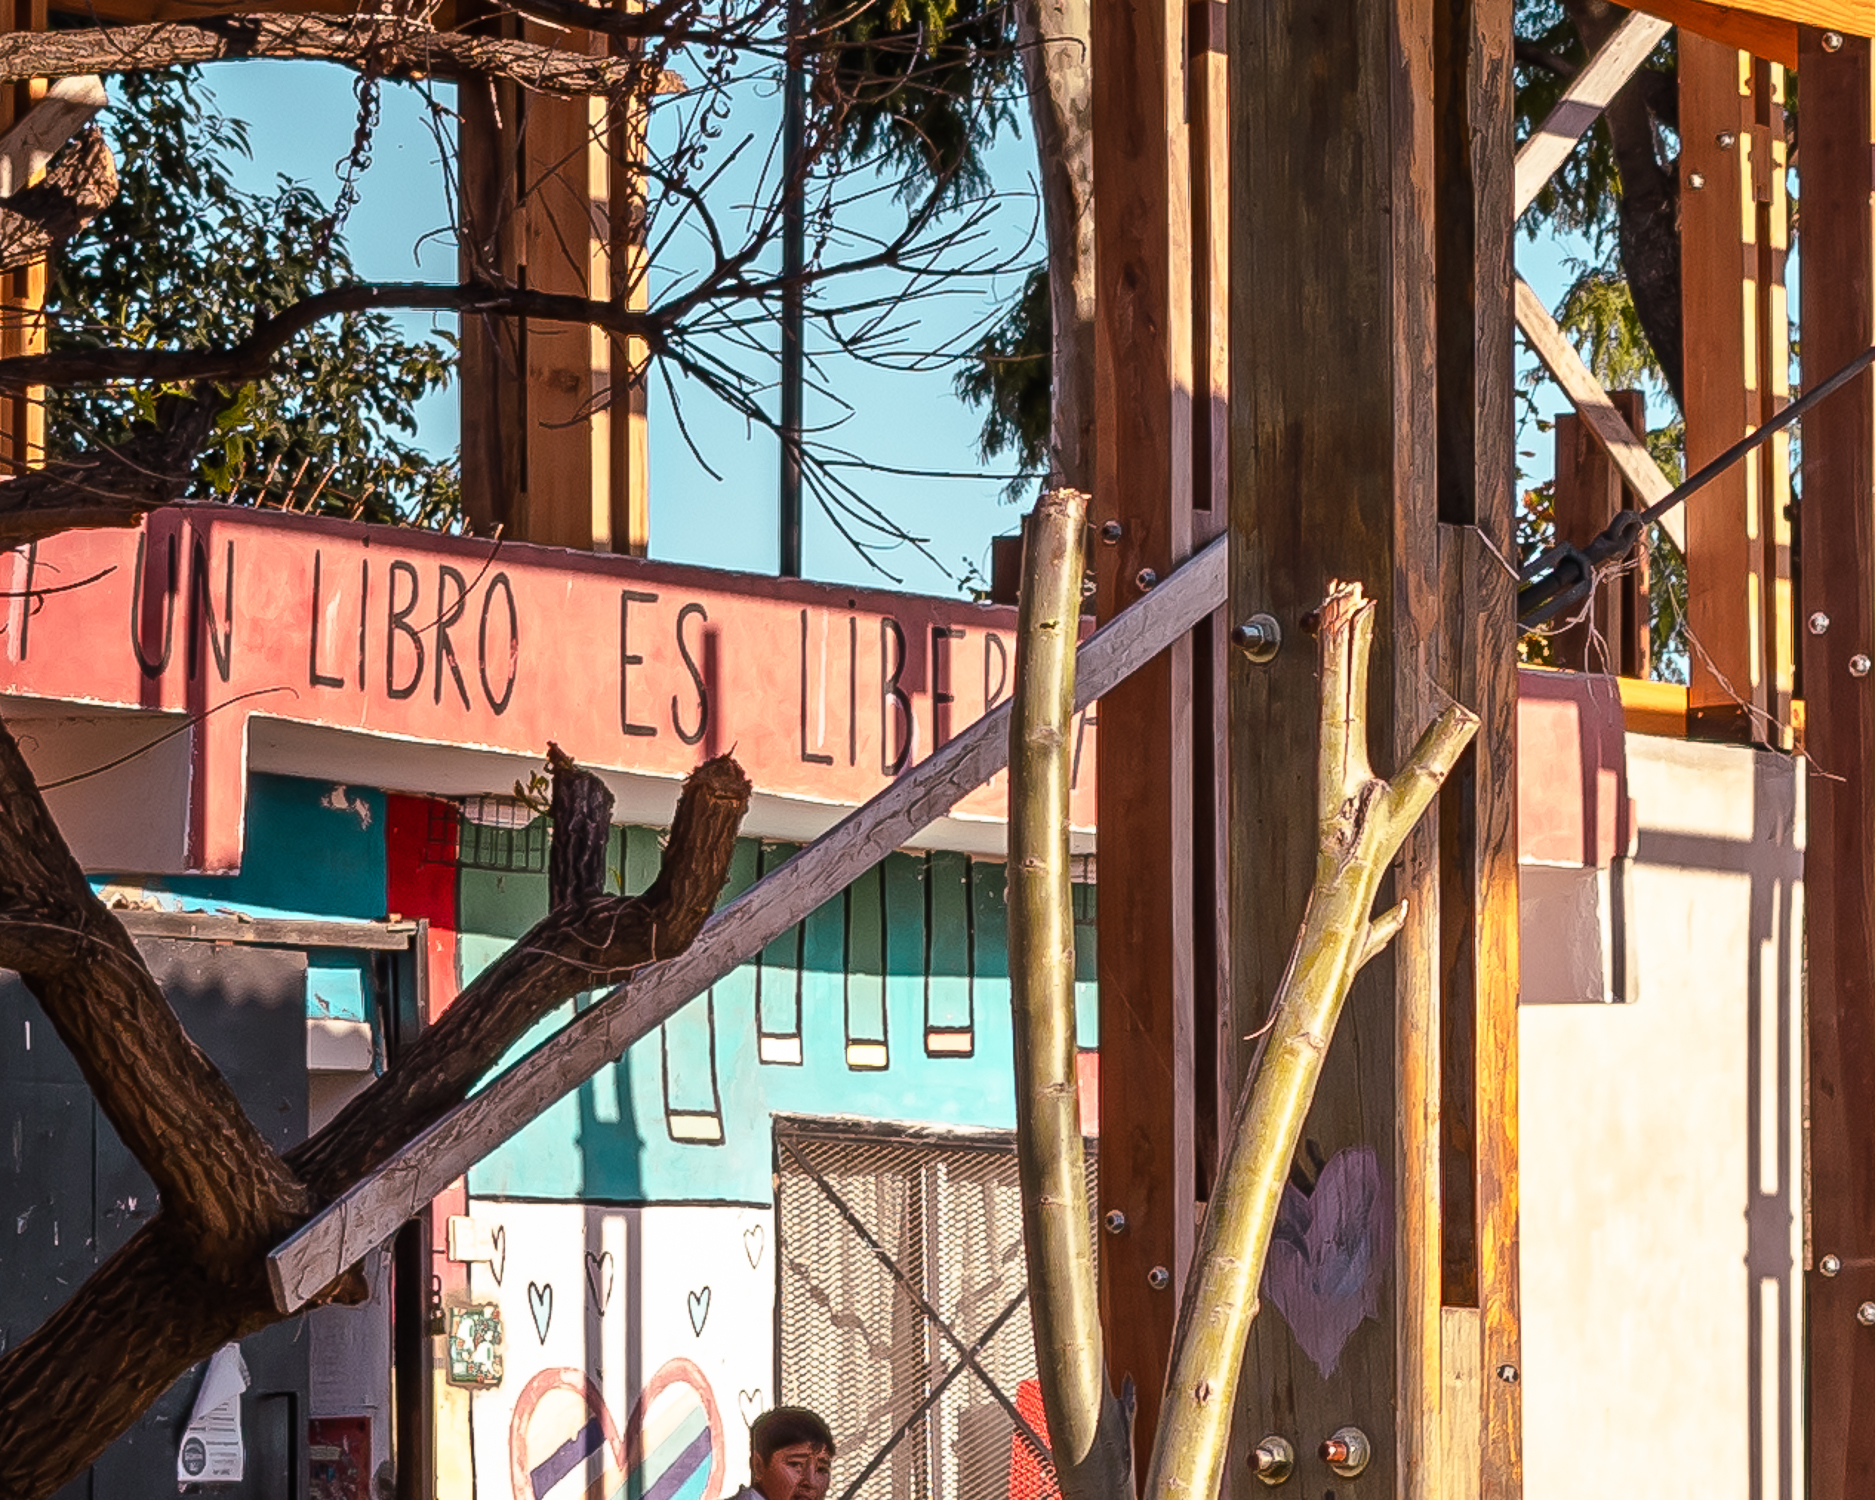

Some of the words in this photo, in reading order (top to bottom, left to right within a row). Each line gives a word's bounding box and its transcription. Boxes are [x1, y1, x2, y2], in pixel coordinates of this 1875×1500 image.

[131, 531, 234, 683] UN
[309, 534, 519, 716] LIBRO
[620, 589, 709, 746] ES
